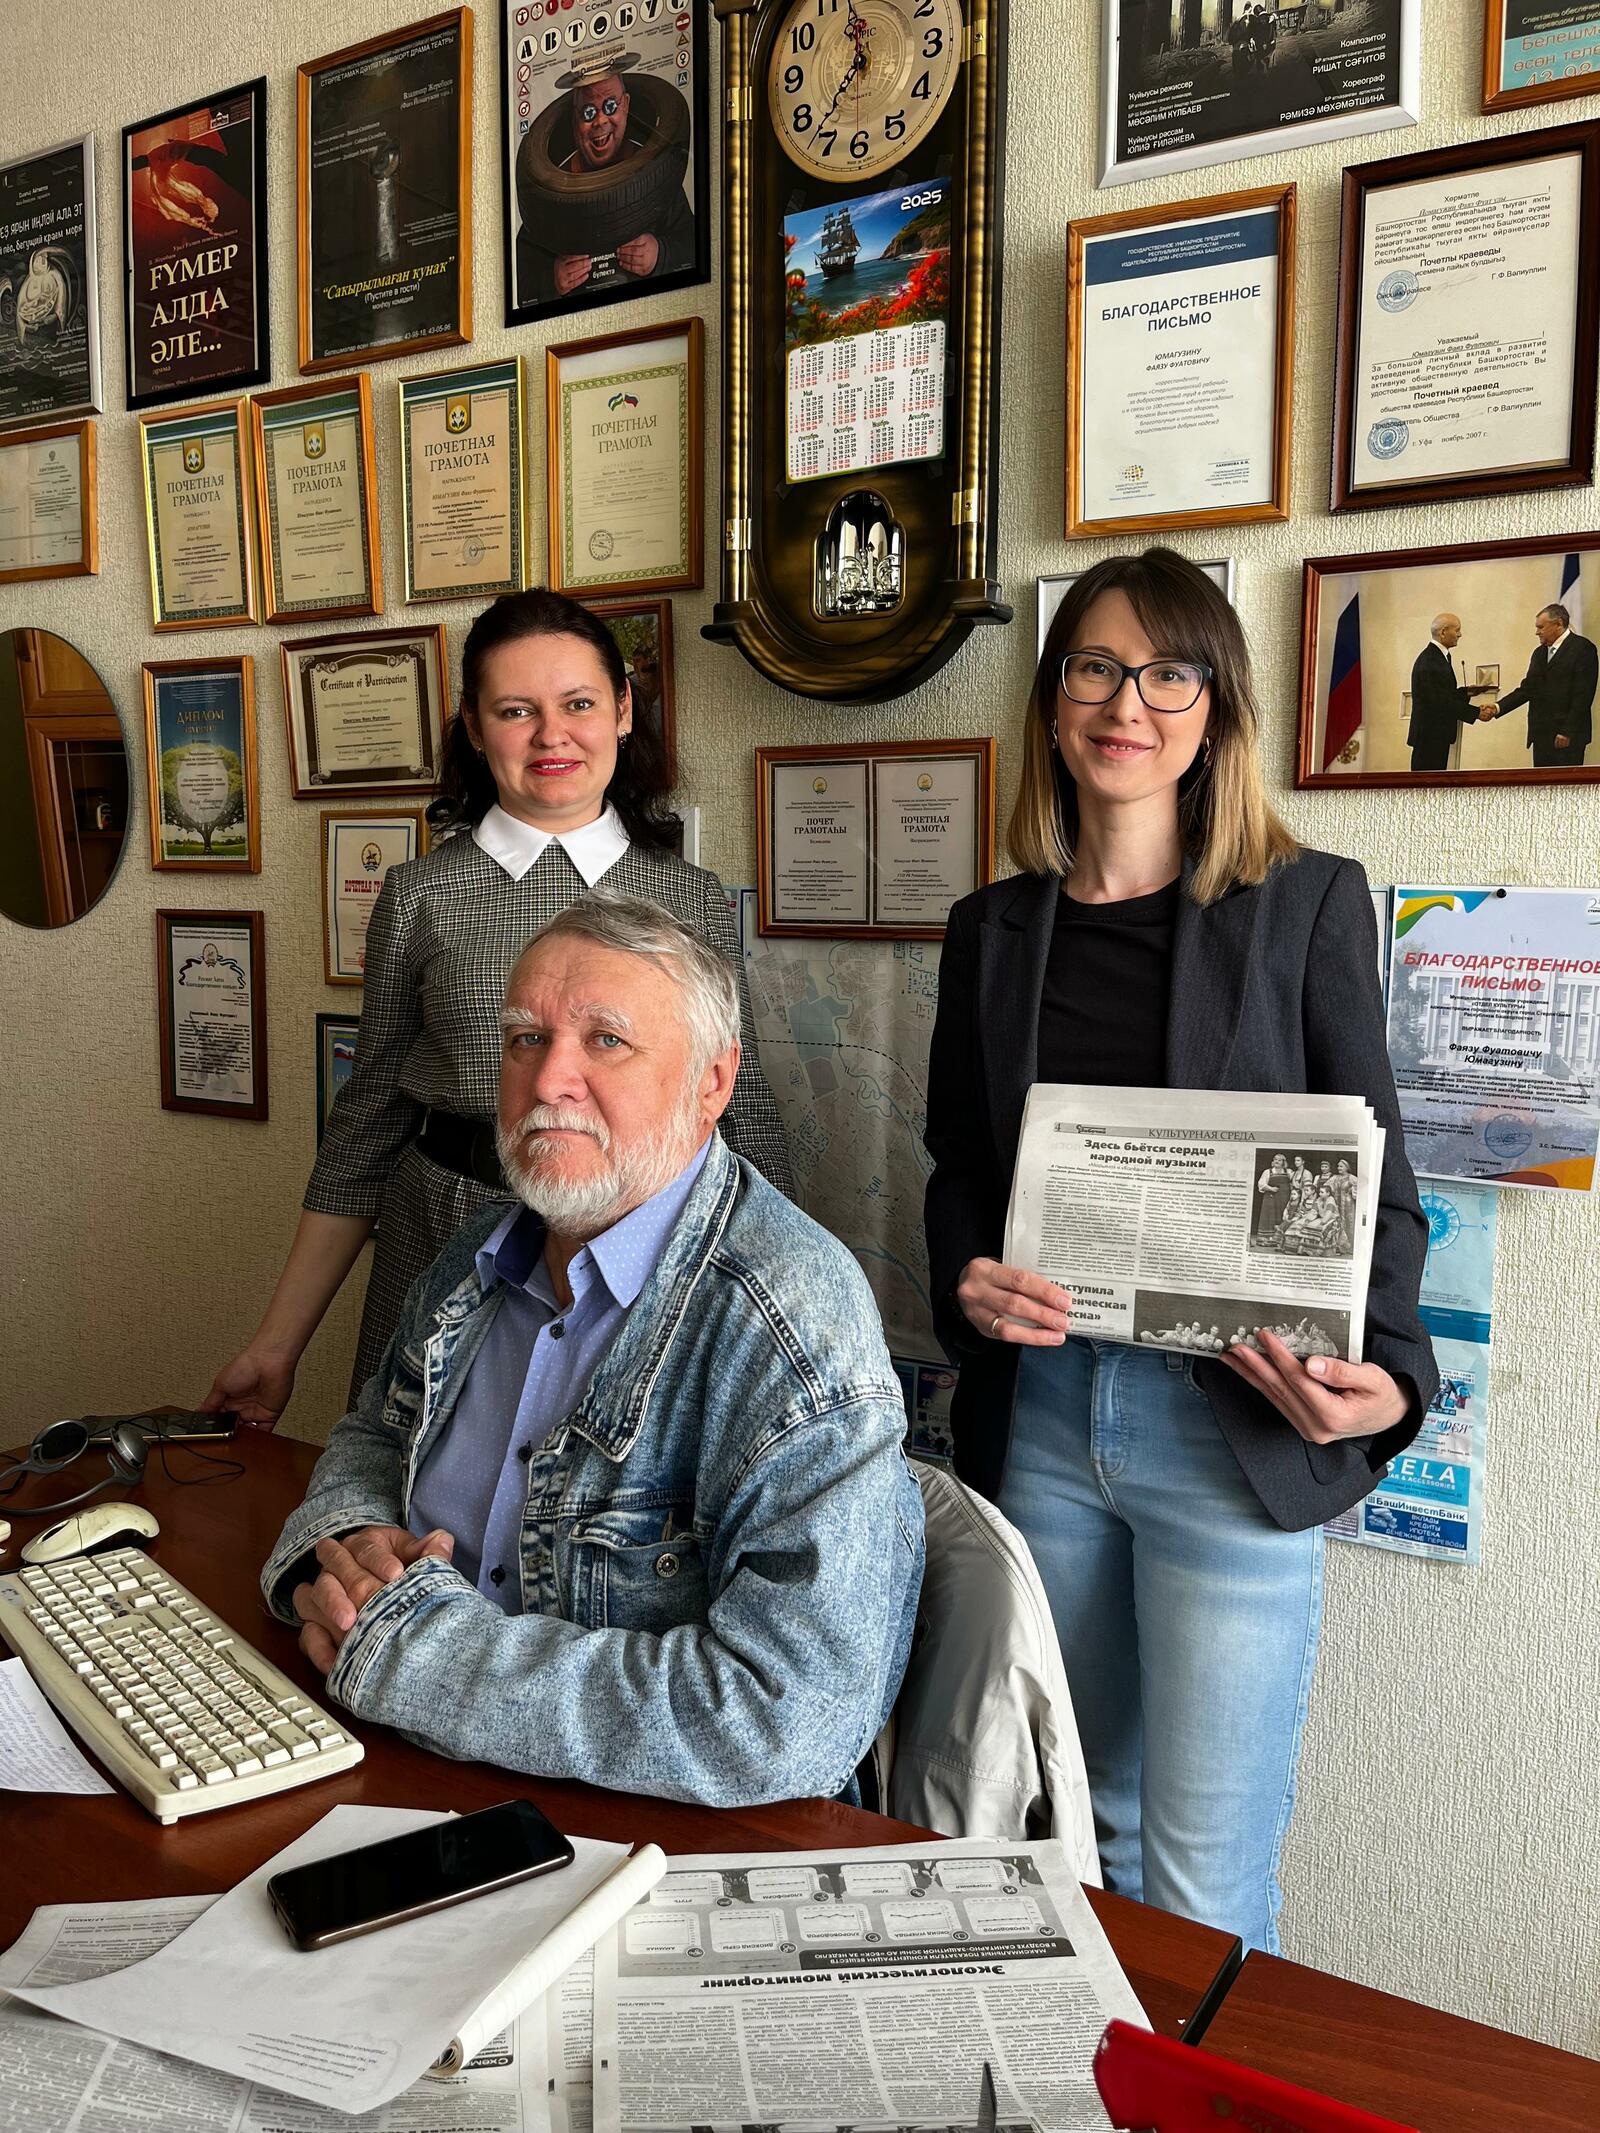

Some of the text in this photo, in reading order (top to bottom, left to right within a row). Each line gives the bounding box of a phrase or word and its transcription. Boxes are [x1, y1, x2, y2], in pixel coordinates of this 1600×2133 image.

[817, 0, 838, 16] 11
[914, 0, 935, 19] 2
[1522, 12, 1560, 24] Спектакль
[410, 44, 430, 57] ДРАМА
[431, 36, 454, 49] ТЕАТРЫ
[791, 22, 815, 54] 10
[922, 28, 943, 58] 3
[1340, 33, 1386, 48] Композитор
[1312, 61, 1342, 74] РИШАТ
[1344, 52, 1386, 68] СӘҒИТОВ
[1514, 55, 1556, 72] өсөн
[784, 65, 804, 94] 9
[910, 70, 932, 100] 4
[1160, 81, 1194, 95] режиссер
[1342, 74, 1385, 88] Хореограф
[792, 104, 813, 133] 8
[1280, 106, 1314, 122] РӘМИЗӘ
[884, 109, 906, 140] 5
[819, 129, 838, 157] 7
[850, 131, 870, 158] 6
[1128, 142, 1150, 154] ЮЛИӘ
[900, 189, 942, 211] 2025
[56, 206, 72, 221] АЛА
[74, 203, 83, 216] ЭТ
[44, 230, 63, 244] краем
[66, 224, 83, 236] моря
[1128, 232, 1240, 255] ГОСУДАРСТВЕННОЕ УНИТАРНОЕ ПРЕДПРИЯТИЕ
[1148, 241, 1219, 257] РЕСПУБЛИКИ БАШКОРТОСТАН
[1122, 257, 1158, 268] ИЗДАТЕЛЬСКИЙ
[1420, 248, 1501, 268] Почетлы краеведы
[364, 290, 393, 304] (Пустите
[400, 282, 420, 294] гости)
[150, 287, 230, 328] АЛДА
[1102, 285, 1261, 321] БЛАГОДАРСТВЕННОЕ
[1148, 311, 1212, 332] ПИСЬМО
[150, 330, 222, 364] ӘЛЕ...
[1437, 333, 1478, 346] Уважаемый
[1154, 348, 1202, 361] ЮМАГУЗИНУ
[1388, 360, 1422, 370] большой
[1429, 354, 1460, 363] личный
[1466, 349, 1490, 358] вклад
[1508, 340, 1547, 351] развитие
[911, 367, 929, 376] Август
[1146, 356, 1210, 372] ФАЯЗУ ФУАТОВИЧУ
[1371, 368, 1420, 381] краеведения
[1426, 361, 1472, 372] Республики
[1478, 351, 1536, 364] Башкортостан
[1371, 380, 1406, 390] активную
[1412, 370, 1468, 383] общественную
[1474, 361, 1528, 374] деятельность
[1370, 384, 1433, 398] удостоены звания
[1380, 386, 1534, 414] общества краеведов Республики Башкортостан
[1414, 382, 1500, 400] Почетный краевед
[592, 415, 657, 437] ПОЧЕТНАЯ
[1423, 412, 1460, 422] Общества
[424, 434, 496, 457] ПОЧЕТНАЯ
[599, 434, 652, 454] ГРАМОТА
[1441, 434, 1464, 443] ноябрь
[1466, 432, 1482, 440] 2007
[287, 460, 346, 480] ПОЧЕТНАЯ
[430, 452, 490, 472] ГРАМОТА
[167, 474, 225, 494] ПОЧЕТНАЯ
[293, 476, 343, 494] ГРАМОТА
[172, 490, 221, 508] ГРАМОТА
[320, 678, 354, 692] Certificate
[365, 674, 408, 688] Participation
[176, 710, 224, 725] ДИПЛОМ
[806, 817, 834, 826] ПОЧЕТ
[900, 815, 950, 824] ПОЧЕТНАЯ
[904, 824, 946, 834] ГРАМОТА
[1404, 952, 1600, 975] БЛАГОДАРСТВЕННОЕ
[1460, 974, 1542, 992] ПИСЬМО
[1449, 1043, 1542, 1058] Фаязу Фуатовичу
[1464, 1055, 1524, 1068] Юмагузину
[1148, 1128, 1256, 1142] КУЛЬТУРНАЯ СРЕДА
[1084, 1140, 1215, 1156] Здесь бьётся сердце
[1090, 1153, 1206, 1168] народной музыки
[1072, 1298, 1127, 1310] енческая
[1064, 1310, 1101, 1320] есна»
[1408, 1476, 1456, 1490] ACCESSORIES
[1376, 1497, 1466, 1521] БашИнвестБанк
[1409, 1520, 1441, 1532] КРЕДИТЫ
[1411, 1514, 1439, 1524] ВКЛАДЫ
[1386, 1528, 1465, 1549] ДЕНЕЖНЫЕ ПЕРЕВОДЫ
[1410, 1527, 1440, 1538] ИПОТЕКА
[830, 1948, 1046, 1964] МАКСИМАЛЬНЫЕ ПОКАЗАТЕЛИ КОНЦЕНТРАЦИИ ВЕЩЕСТВ
[924, 1944, 1016, 1954] САНИТАРНО-ЗАЩИТНОЙ
[700, 1965, 1006, 1988] Экологический мониторинг
